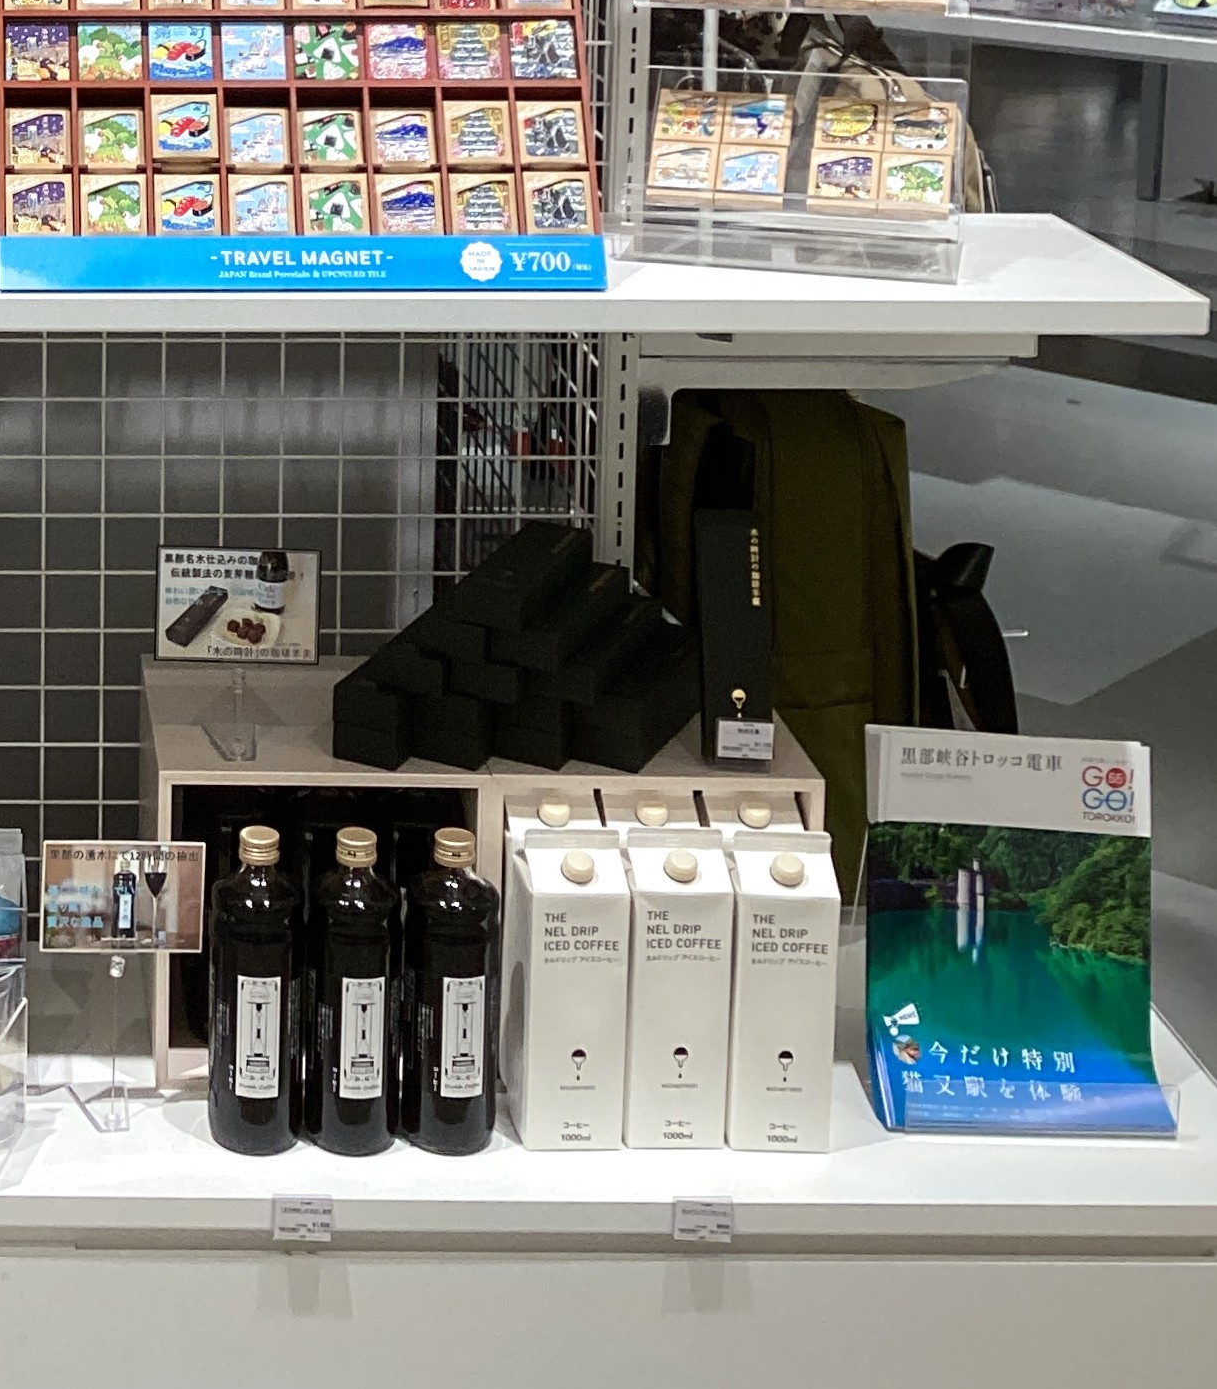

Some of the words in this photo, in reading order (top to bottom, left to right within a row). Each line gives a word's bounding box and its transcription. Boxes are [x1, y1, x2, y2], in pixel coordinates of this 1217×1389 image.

[510, 251, 571, 273] ¥700
[900, 746, 1063, 772] 黒部峡谷トロッコ電車
[545, 913, 567, 923] THE
[647, 911, 669, 921] THE
[753, 914, 776, 924] THE
[544, 926, 568, 937] NEL
[571, 926, 599, 937] DRIP
[647, 924, 670, 935] NEL
[673, 925, 701, 935] DRIP
[752, 928, 776, 939] NEL
[780, 929, 808, 939] DRIP
[544, 941, 570, 951] ICED
[573, 941, 619, 951] COFFEE
[646, 939, 673, 949] ICED
[676, 939, 722, 950] COFFEE
[751, 942, 779, 953] ICED
[782, 943, 829, 955] COFFEE
[928, 1041, 1076, 1074] 今だけ特別
[561, 1133, 591, 1142] 1000ml
[663, 1131, 693, 1140] 1000ml
[766, 1135, 798, 1143] 1000ml
